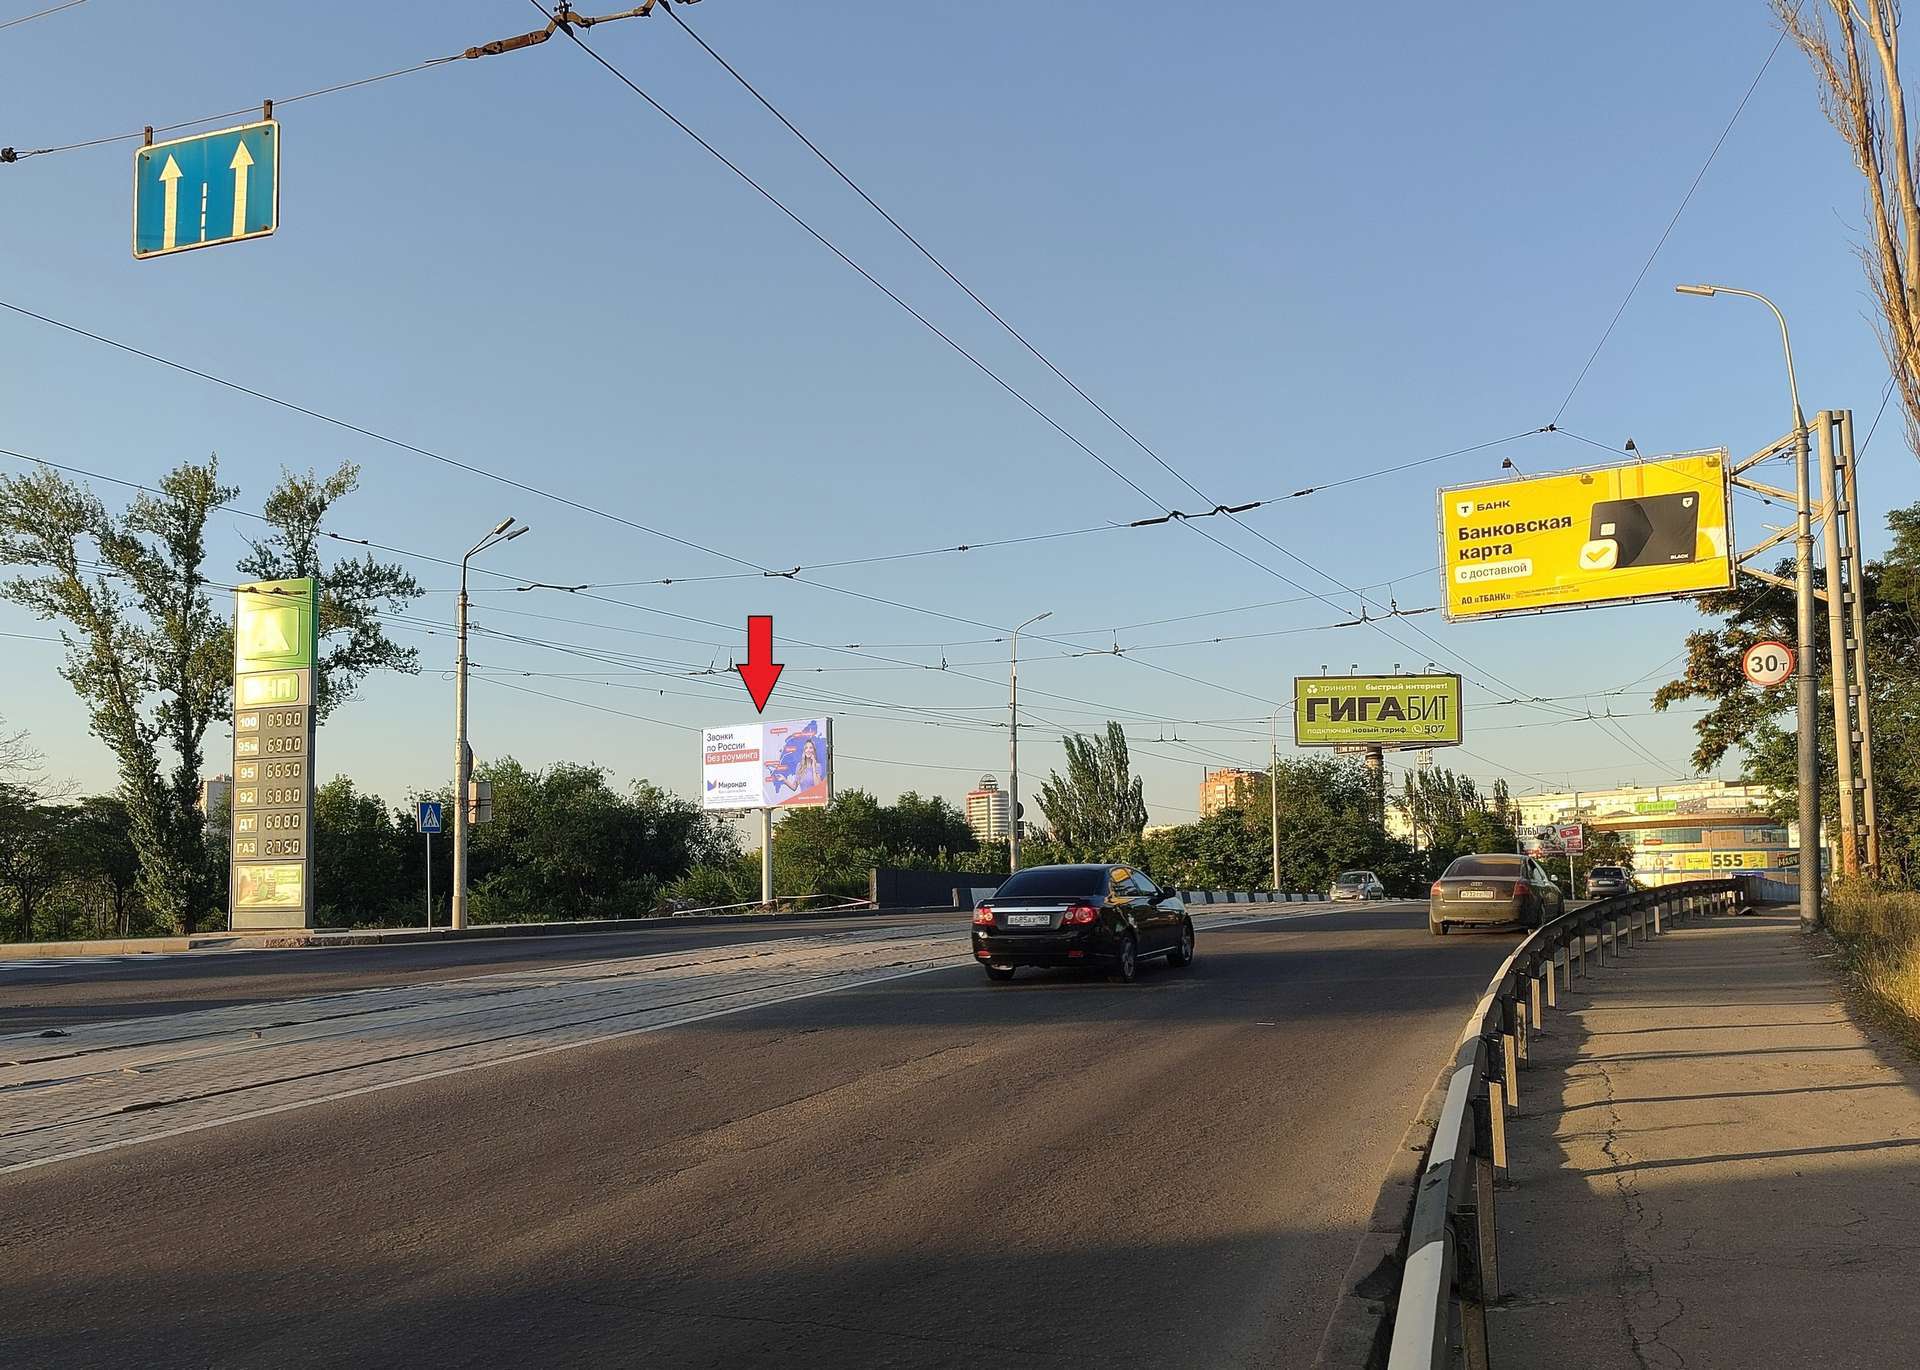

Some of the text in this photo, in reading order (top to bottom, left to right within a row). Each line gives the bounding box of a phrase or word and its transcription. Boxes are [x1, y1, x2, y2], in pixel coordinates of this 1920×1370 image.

[1476, 500, 1510, 511] БАНК
[1458, 515, 1572, 541] Банковская
[1459, 543, 1513, 561] карта
[1460, 563, 1527, 580] с доставкой
[1461, 592, 1511, 605] АО «ТБАНК»
[1751, 655, 1778, 673] 30
[1320, 682, 1447, 692] тринити быстрый интернет!
[1306, 695, 1448, 722] ГИГАБИТ
[240, 717, 257, 728] 100
[1381, 725, 1406, 734] тариф
[1424, 724, 1445, 733] 507
[706, 733, 734, 742] Звонки
[717, 742, 746, 751] России
[706, 752, 759, 762] без роуминга
[240, 768, 254, 778] 95
[718, 781, 747, 789] Миранда
[239, 792, 254, 803] 92
[239, 818, 254, 831] ДТ
[236, 842, 256, 854] ГАЗ
[1713, 854, 1743, 867] 555
